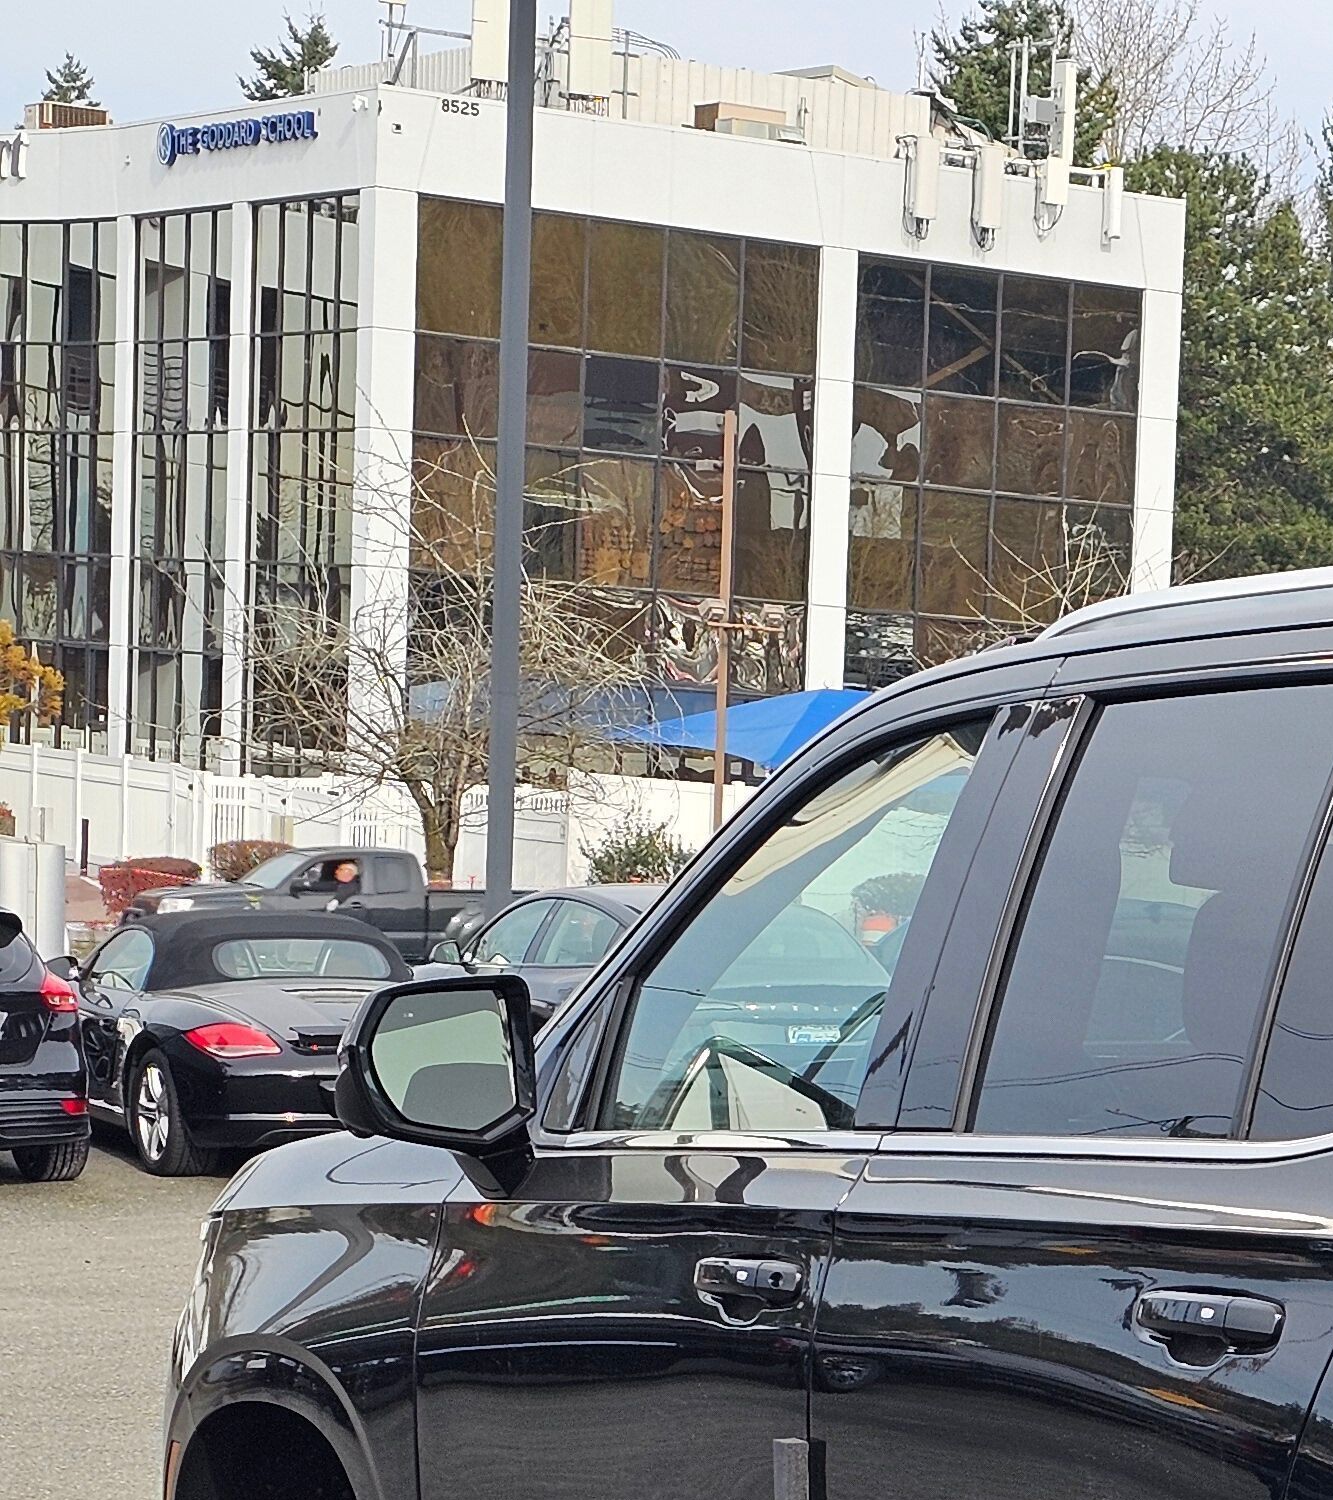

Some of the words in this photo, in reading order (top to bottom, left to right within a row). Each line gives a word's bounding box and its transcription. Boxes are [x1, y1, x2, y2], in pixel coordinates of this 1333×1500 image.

[440, 98, 480, 116] 8525
[173, 128, 197, 154] THE
[200, 119, 258, 149] GODDARD
[260, 111, 316, 142] SCHOOL
